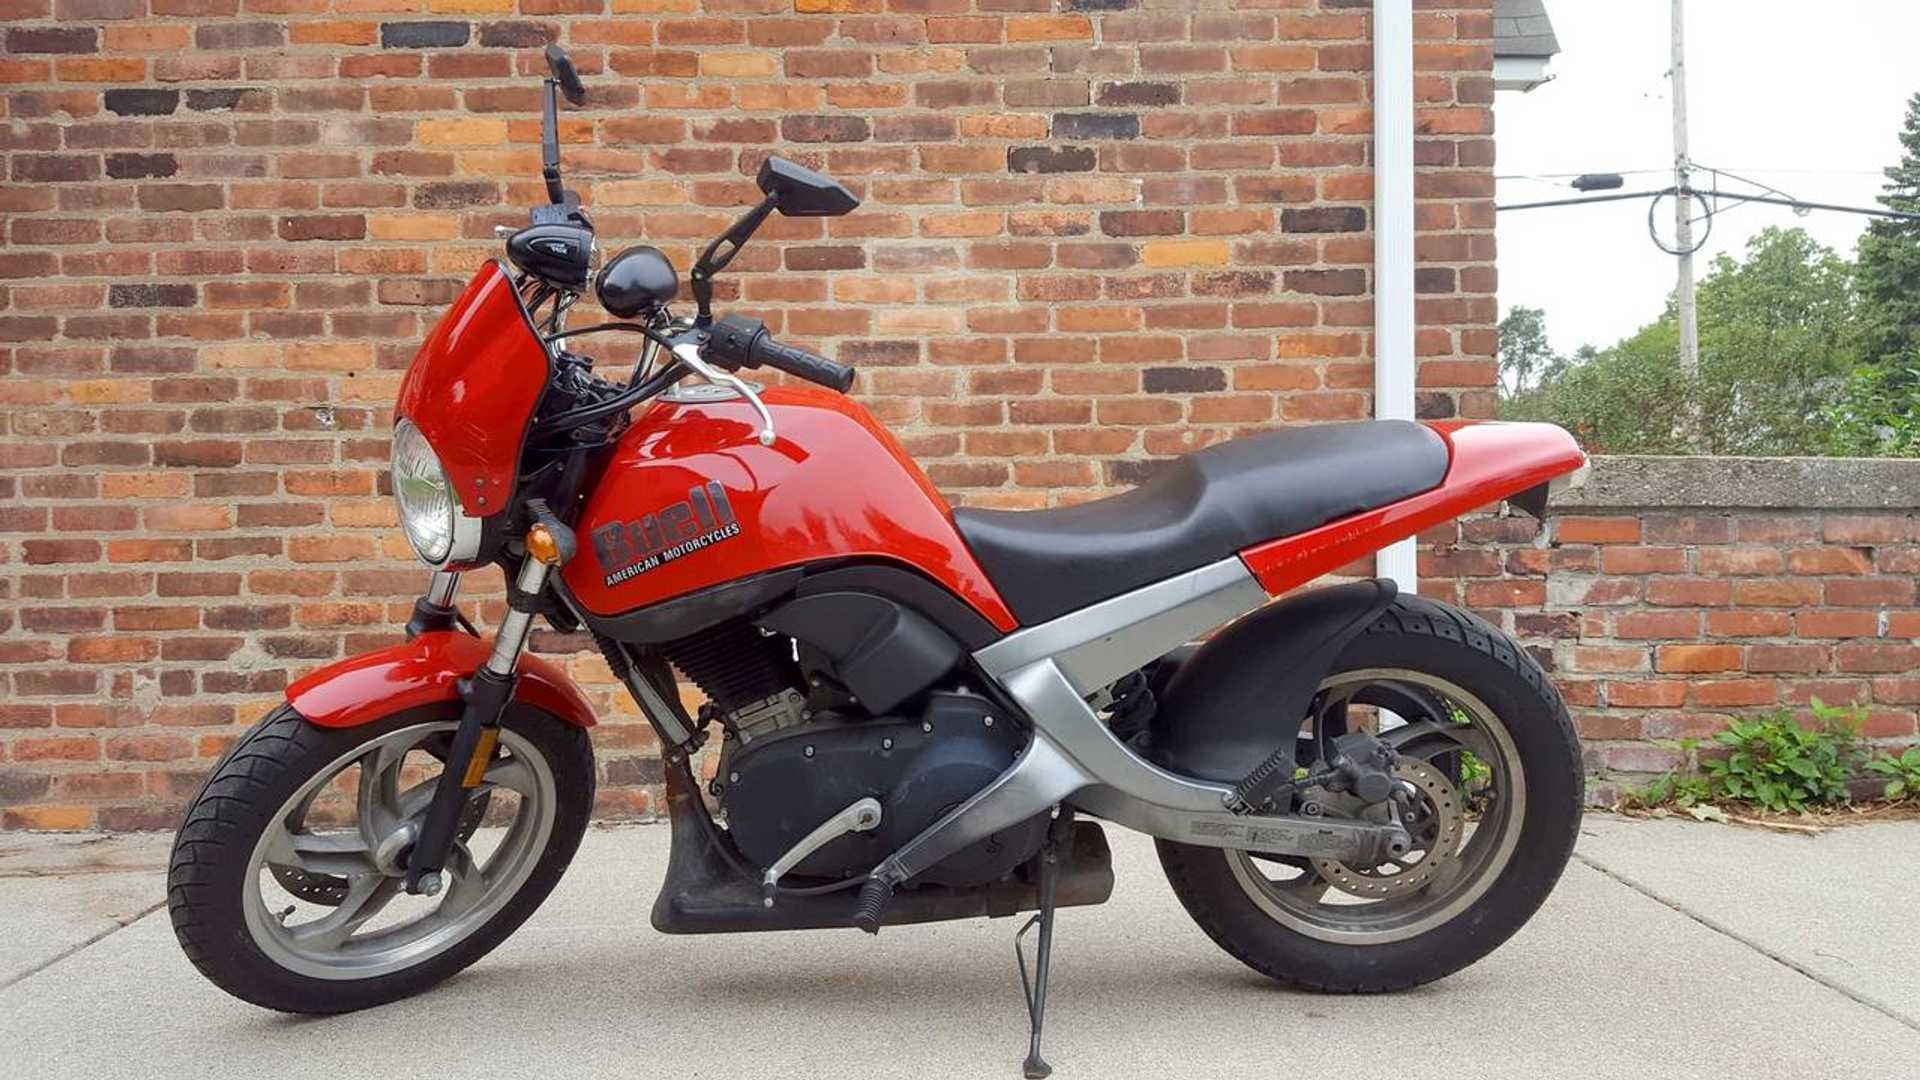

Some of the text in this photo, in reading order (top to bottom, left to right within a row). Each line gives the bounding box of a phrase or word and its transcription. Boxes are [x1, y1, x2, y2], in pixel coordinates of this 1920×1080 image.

[592, 480, 736, 572] Buell
[606, 522, 740, 586] AMERICAN MOTORCYCLES
